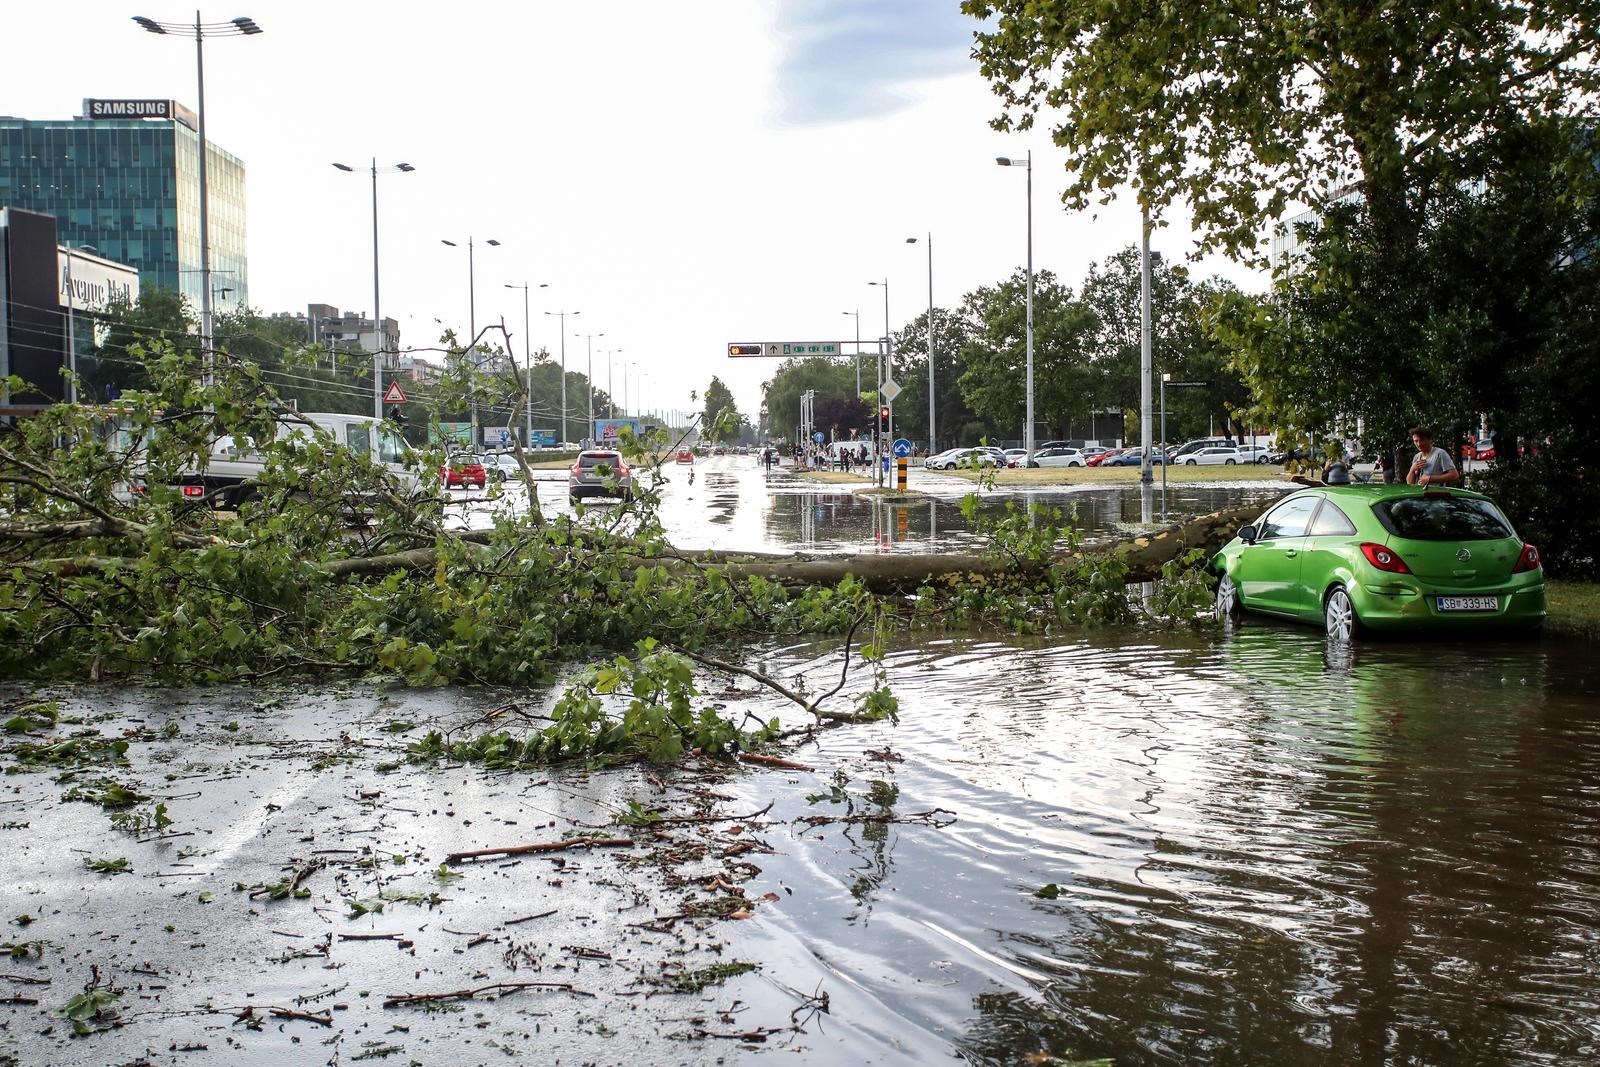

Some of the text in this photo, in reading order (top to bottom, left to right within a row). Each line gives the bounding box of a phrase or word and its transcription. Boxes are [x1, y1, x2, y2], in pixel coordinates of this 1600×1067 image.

[93, 102, 166, 115] SAMSUNG
[60, 266, 105, 304] Avenue
[1444, 598, 1497, 609] SB 339-HS
